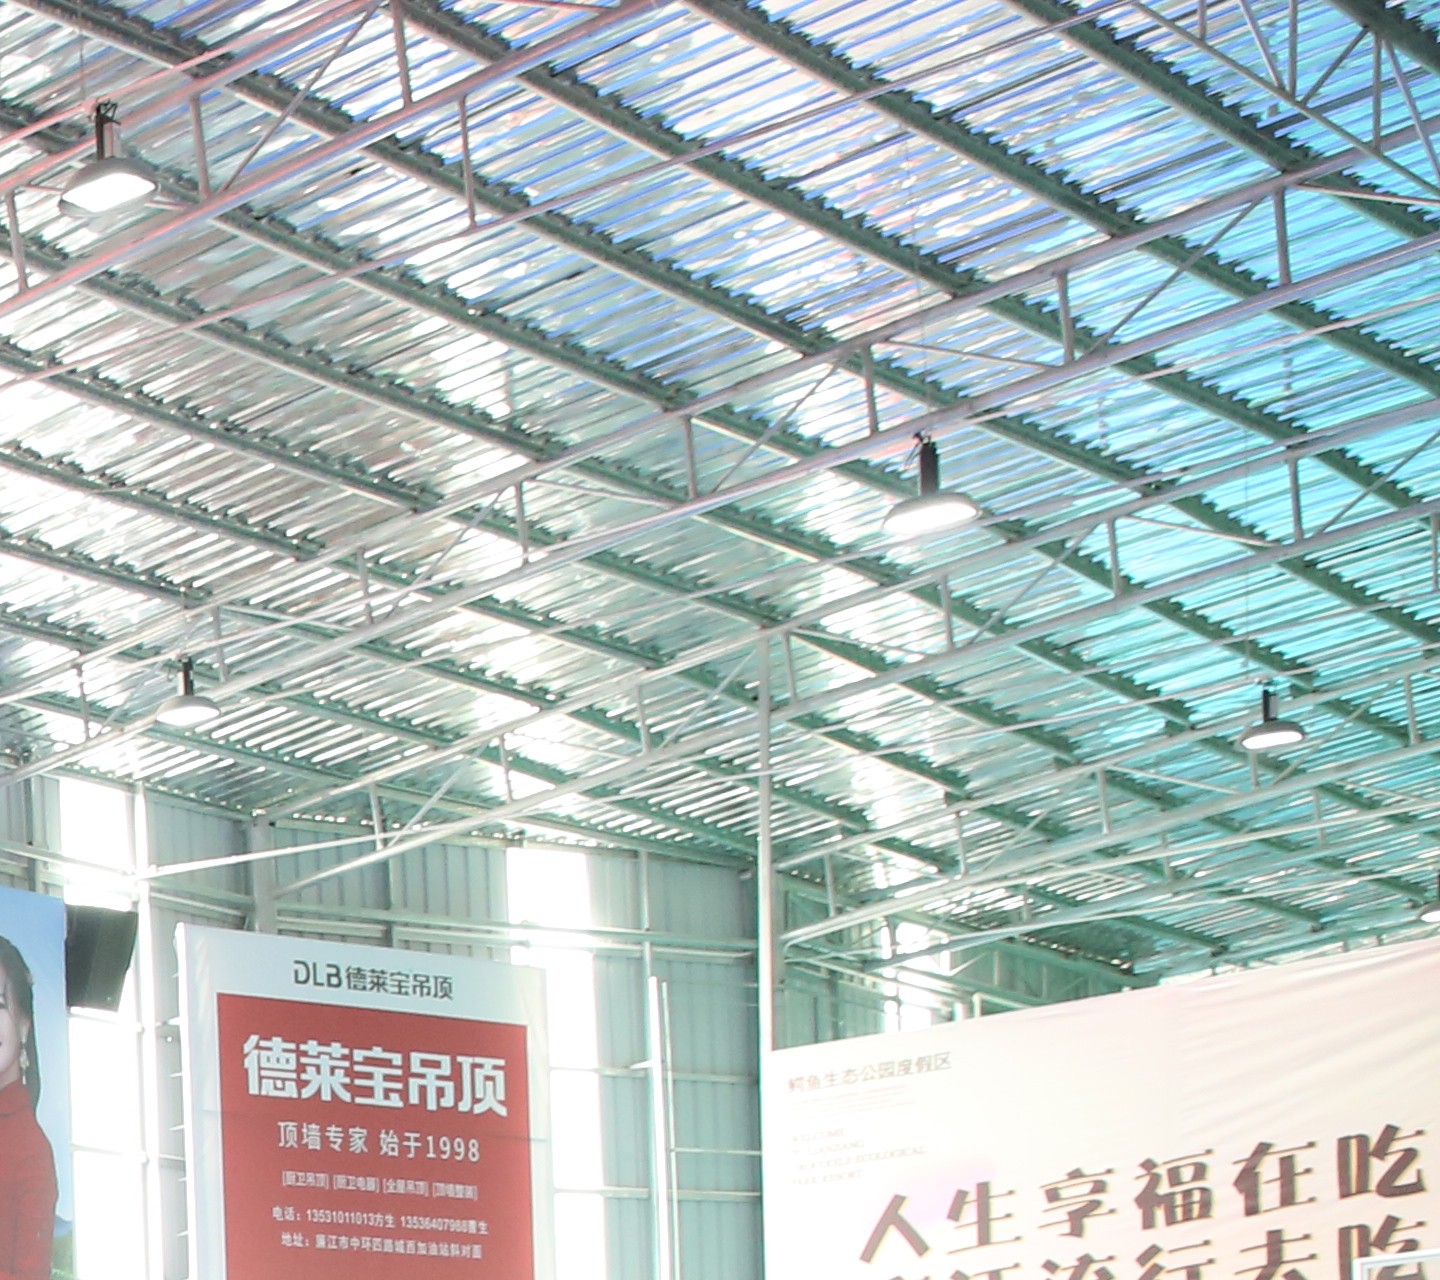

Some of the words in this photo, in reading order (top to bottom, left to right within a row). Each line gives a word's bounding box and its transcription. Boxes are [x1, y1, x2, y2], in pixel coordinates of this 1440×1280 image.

[242, 1034, 509, 1117] 德莱宝吊顶
[277, 1121, 369, 1154] 顶墙专家
[379, 1128, 481, 1163] 始于1998
[858, 1122, 1427, 1265] 人生享福在吃
